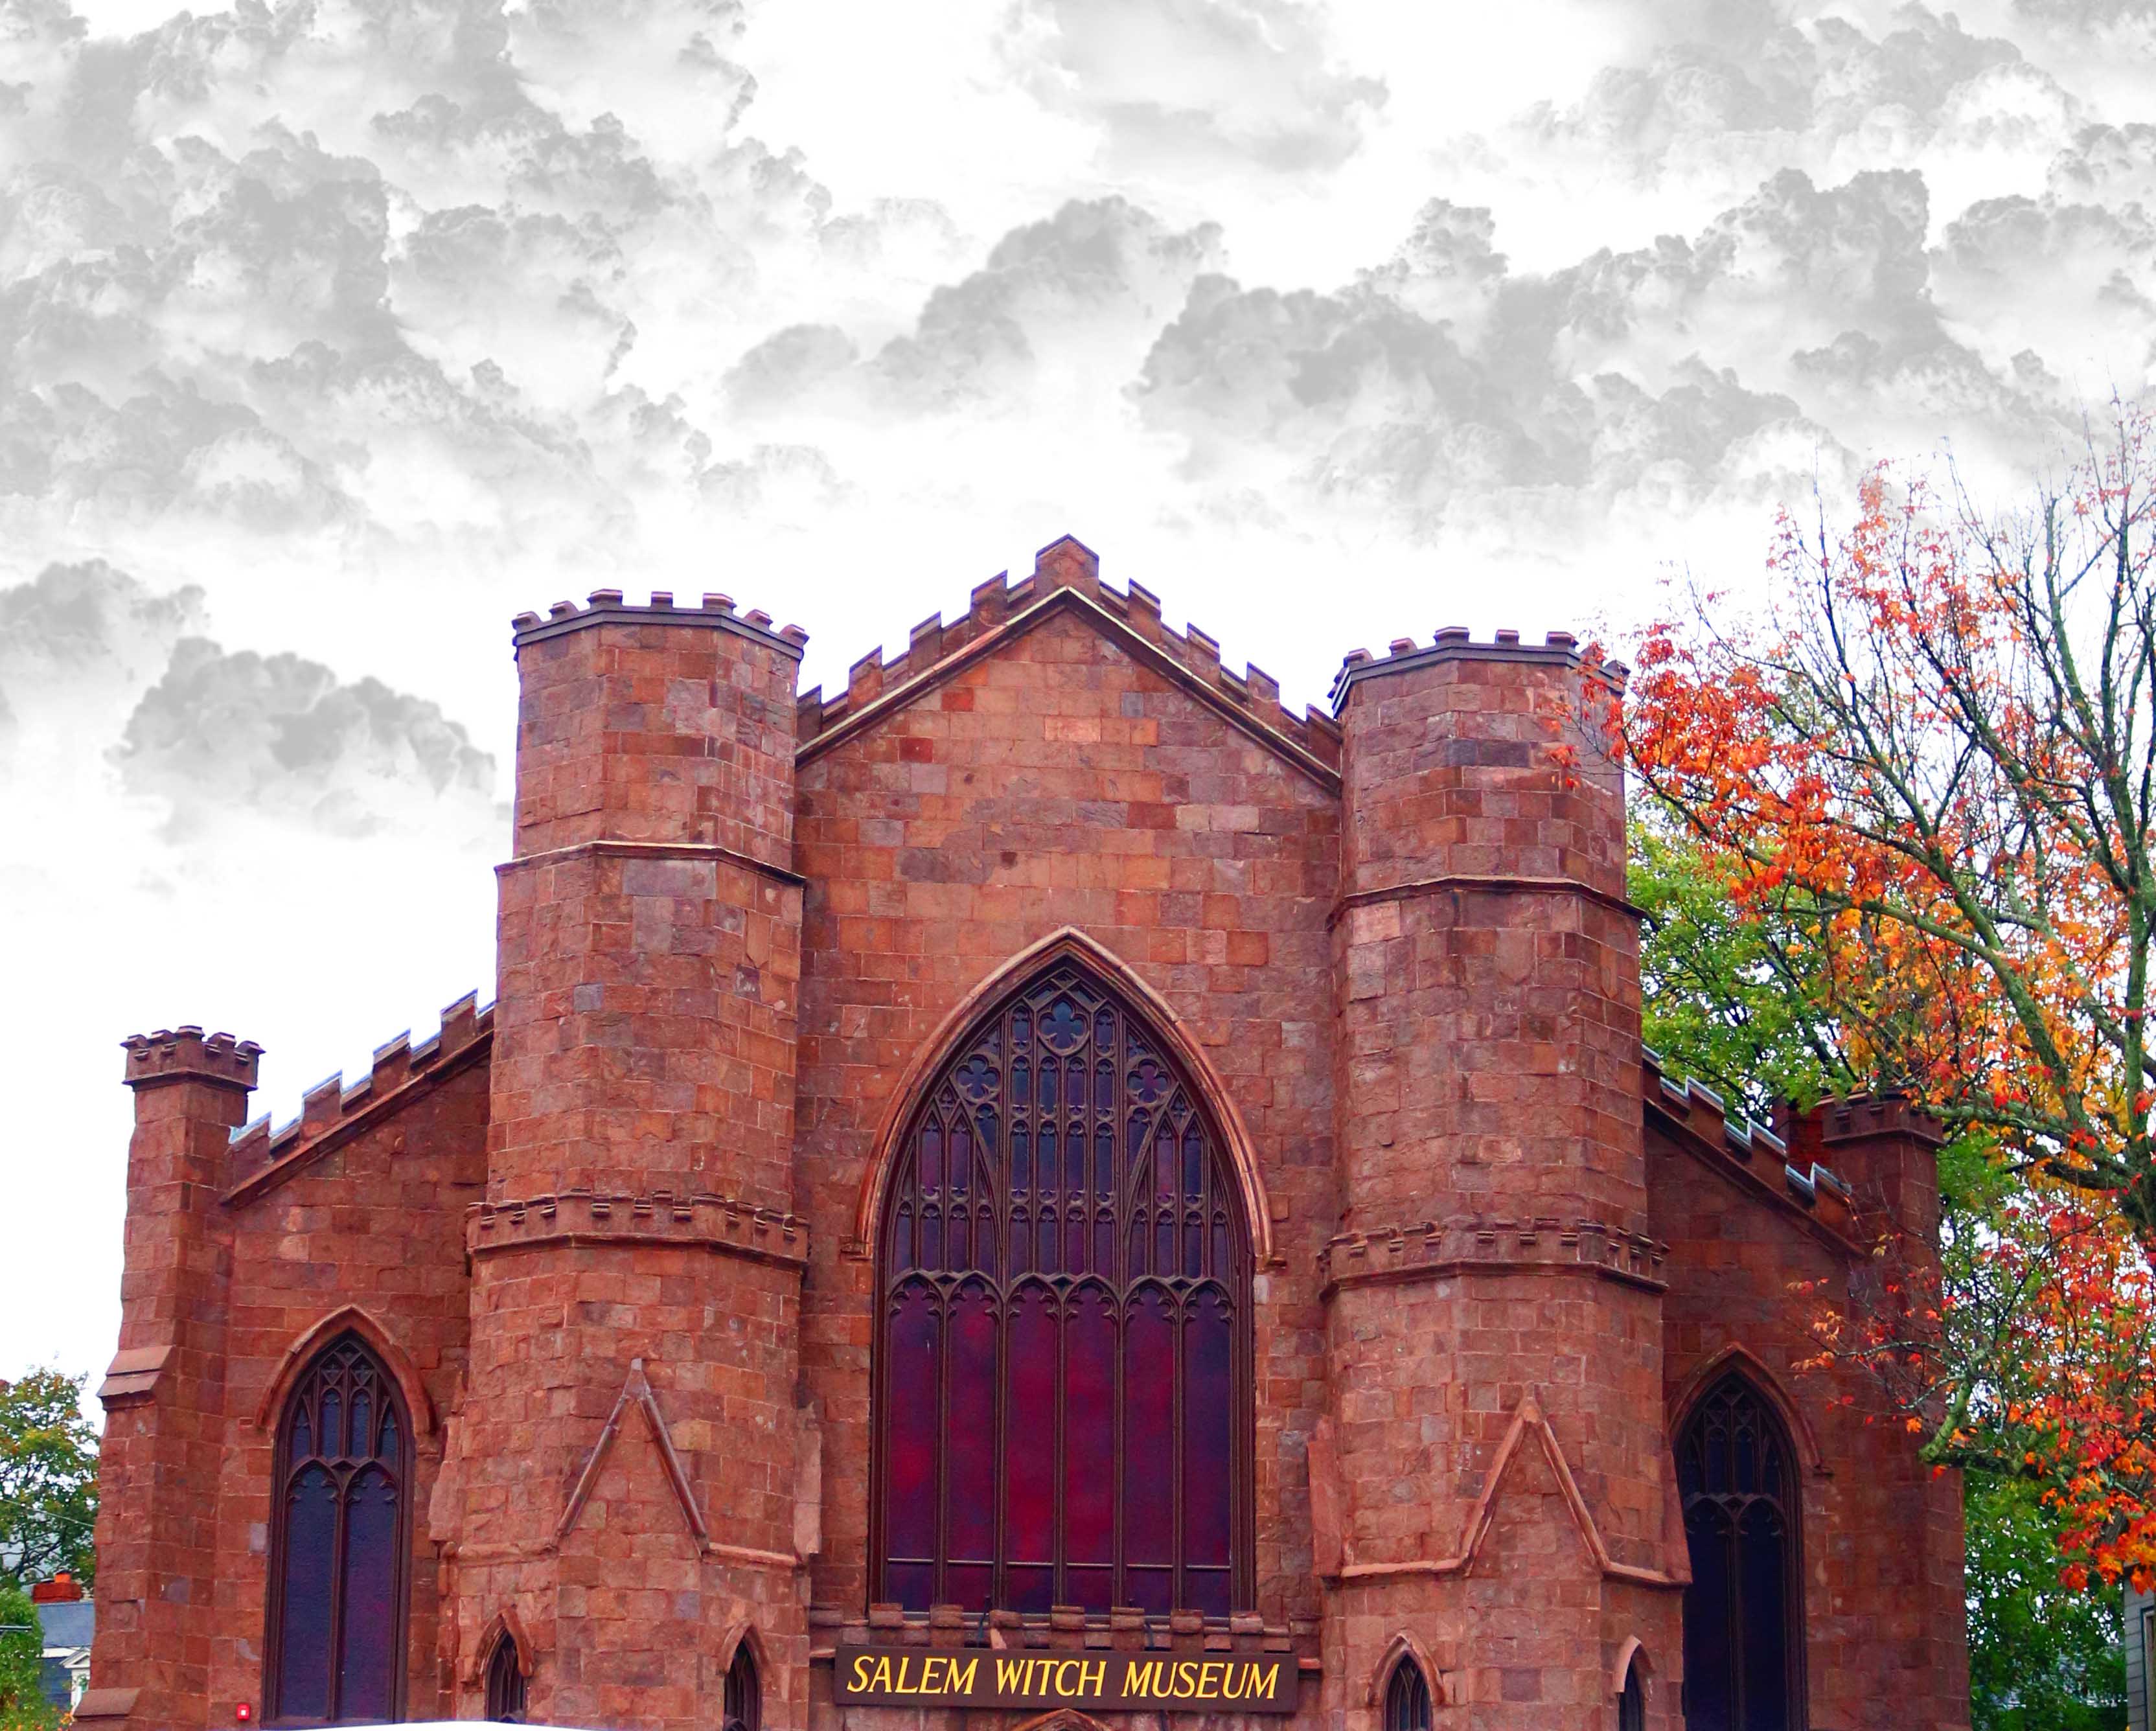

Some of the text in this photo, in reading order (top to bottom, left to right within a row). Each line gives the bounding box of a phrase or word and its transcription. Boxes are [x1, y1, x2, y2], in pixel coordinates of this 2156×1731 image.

[847, 1655, 1280, 1699] SALEM WITCH MUSEUM
